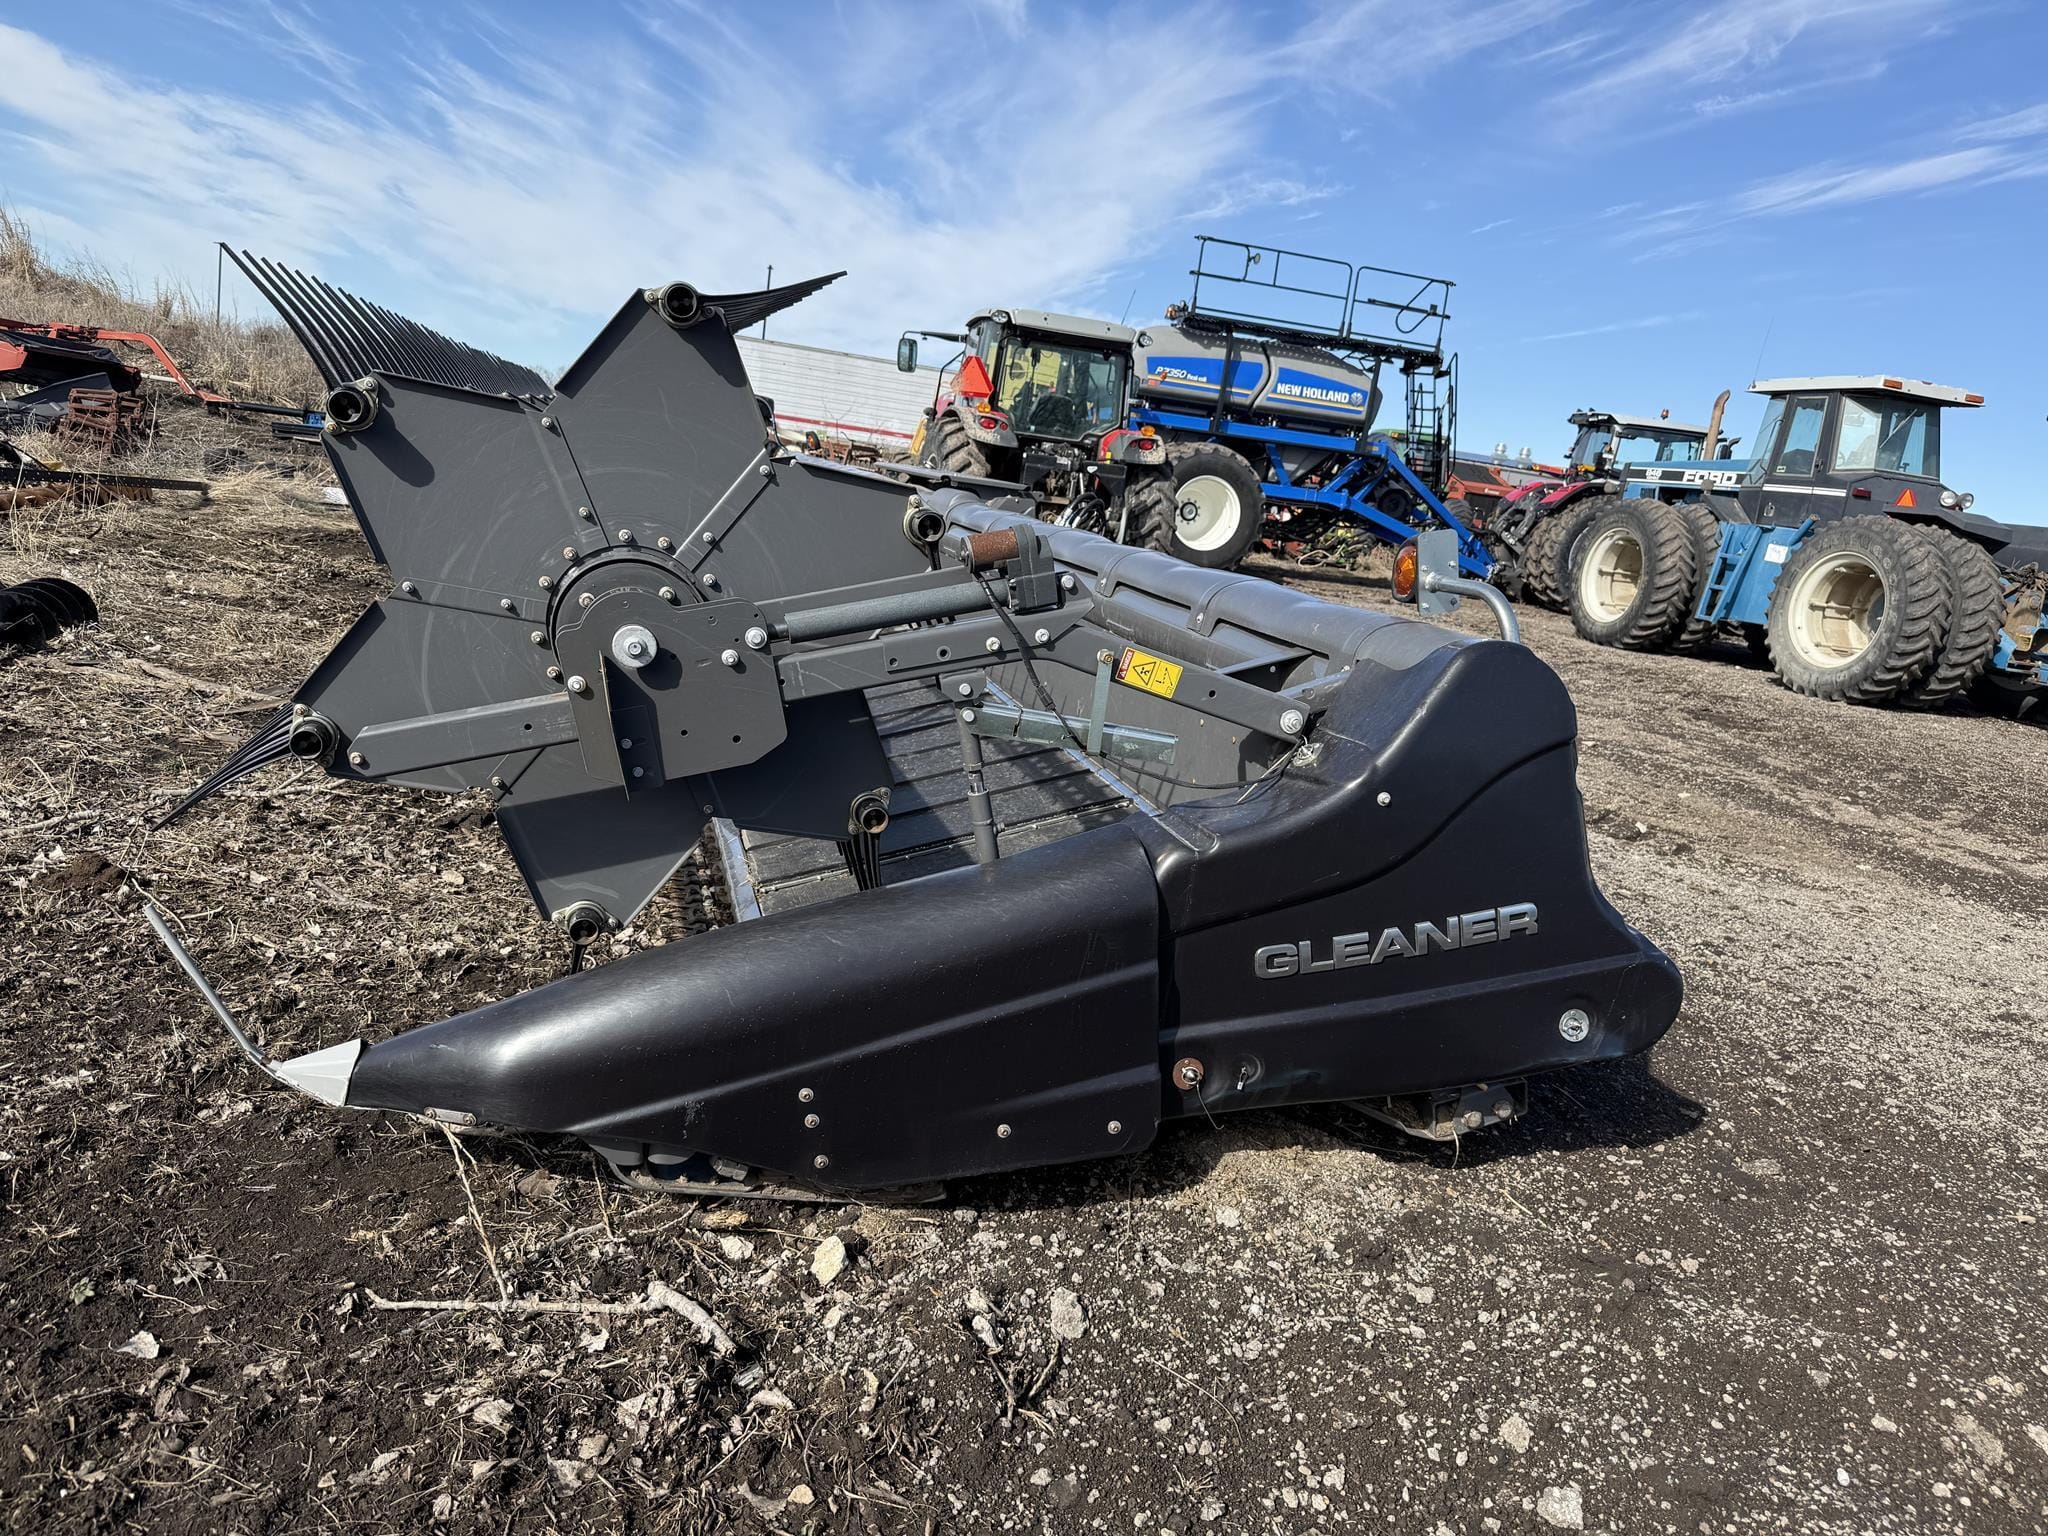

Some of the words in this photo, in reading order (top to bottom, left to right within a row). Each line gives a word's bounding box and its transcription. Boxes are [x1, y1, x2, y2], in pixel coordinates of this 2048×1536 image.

[1277, 383, 1302, 397] NEW
[1302, 386, 1349, 403] HOLLAND
[1682, 471, 1737, 485] FORD
[1254, 902, 1539, 979] GLEANER
